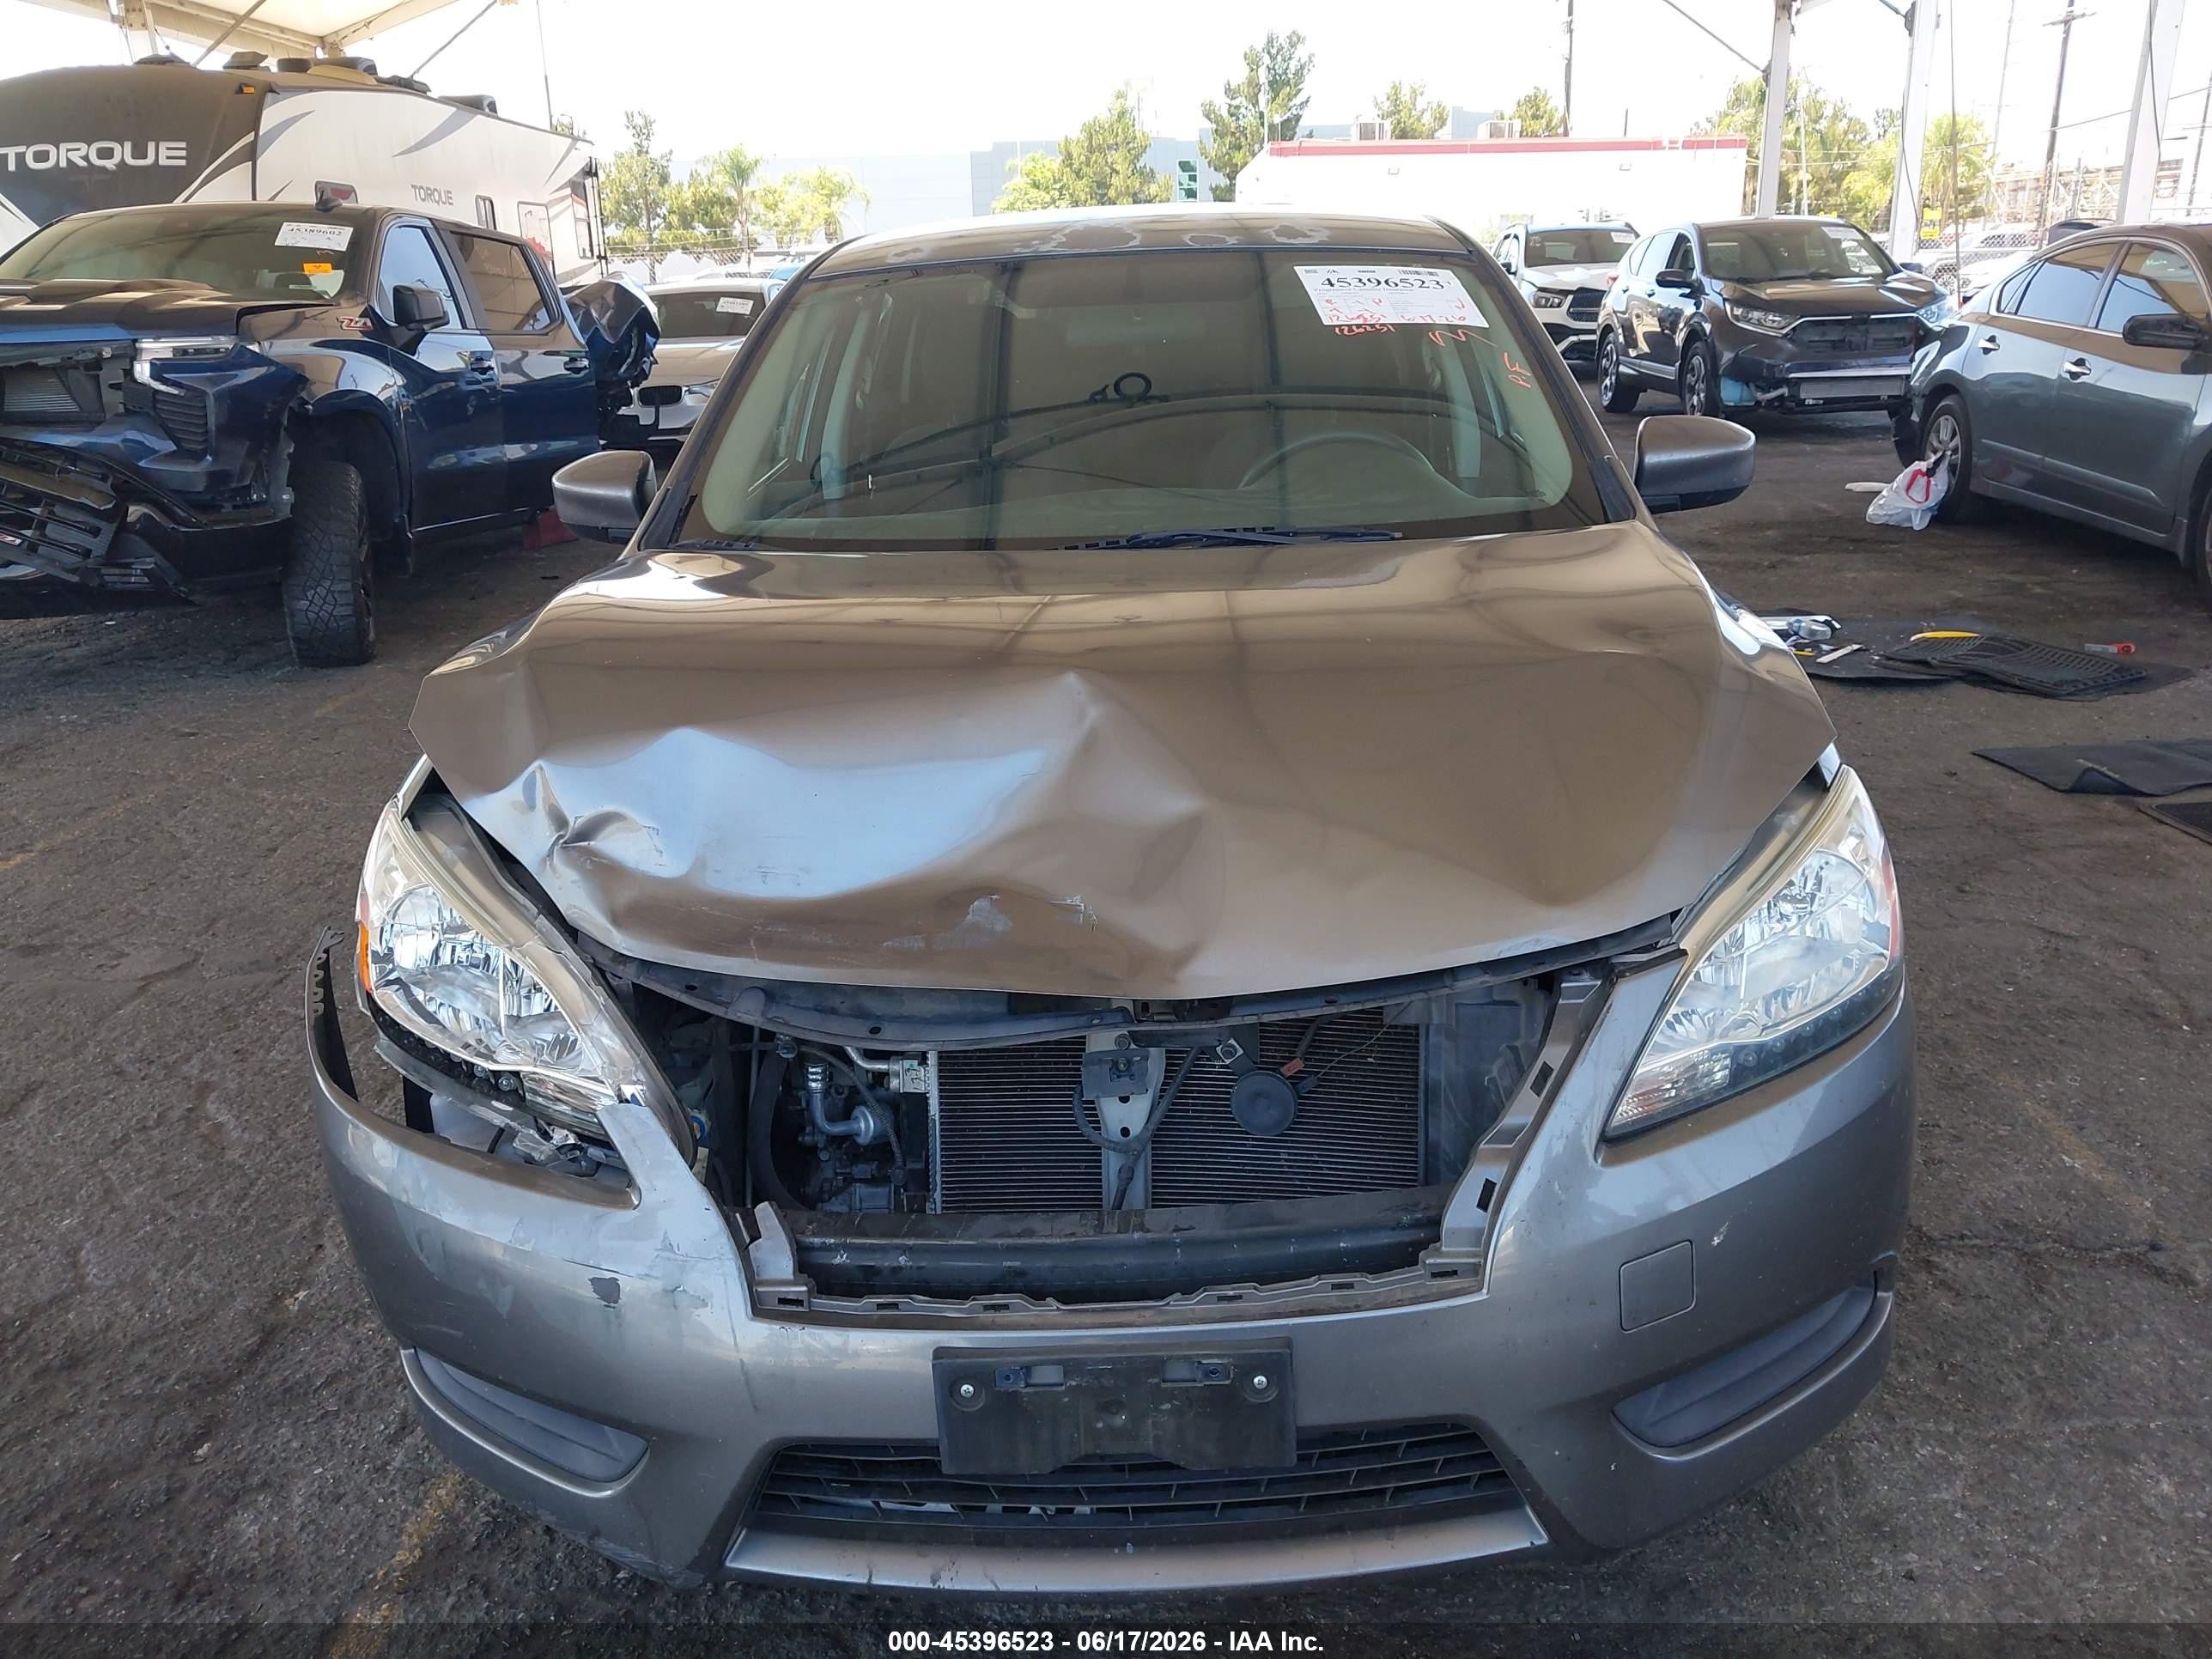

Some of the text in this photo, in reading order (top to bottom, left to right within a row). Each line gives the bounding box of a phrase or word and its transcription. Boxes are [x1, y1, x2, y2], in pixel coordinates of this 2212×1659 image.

[0, 141, 186, 172] TORQUE
[411, 184, 453, 205] TORQUE
[1321, 277, 1445, 290] 45396523
